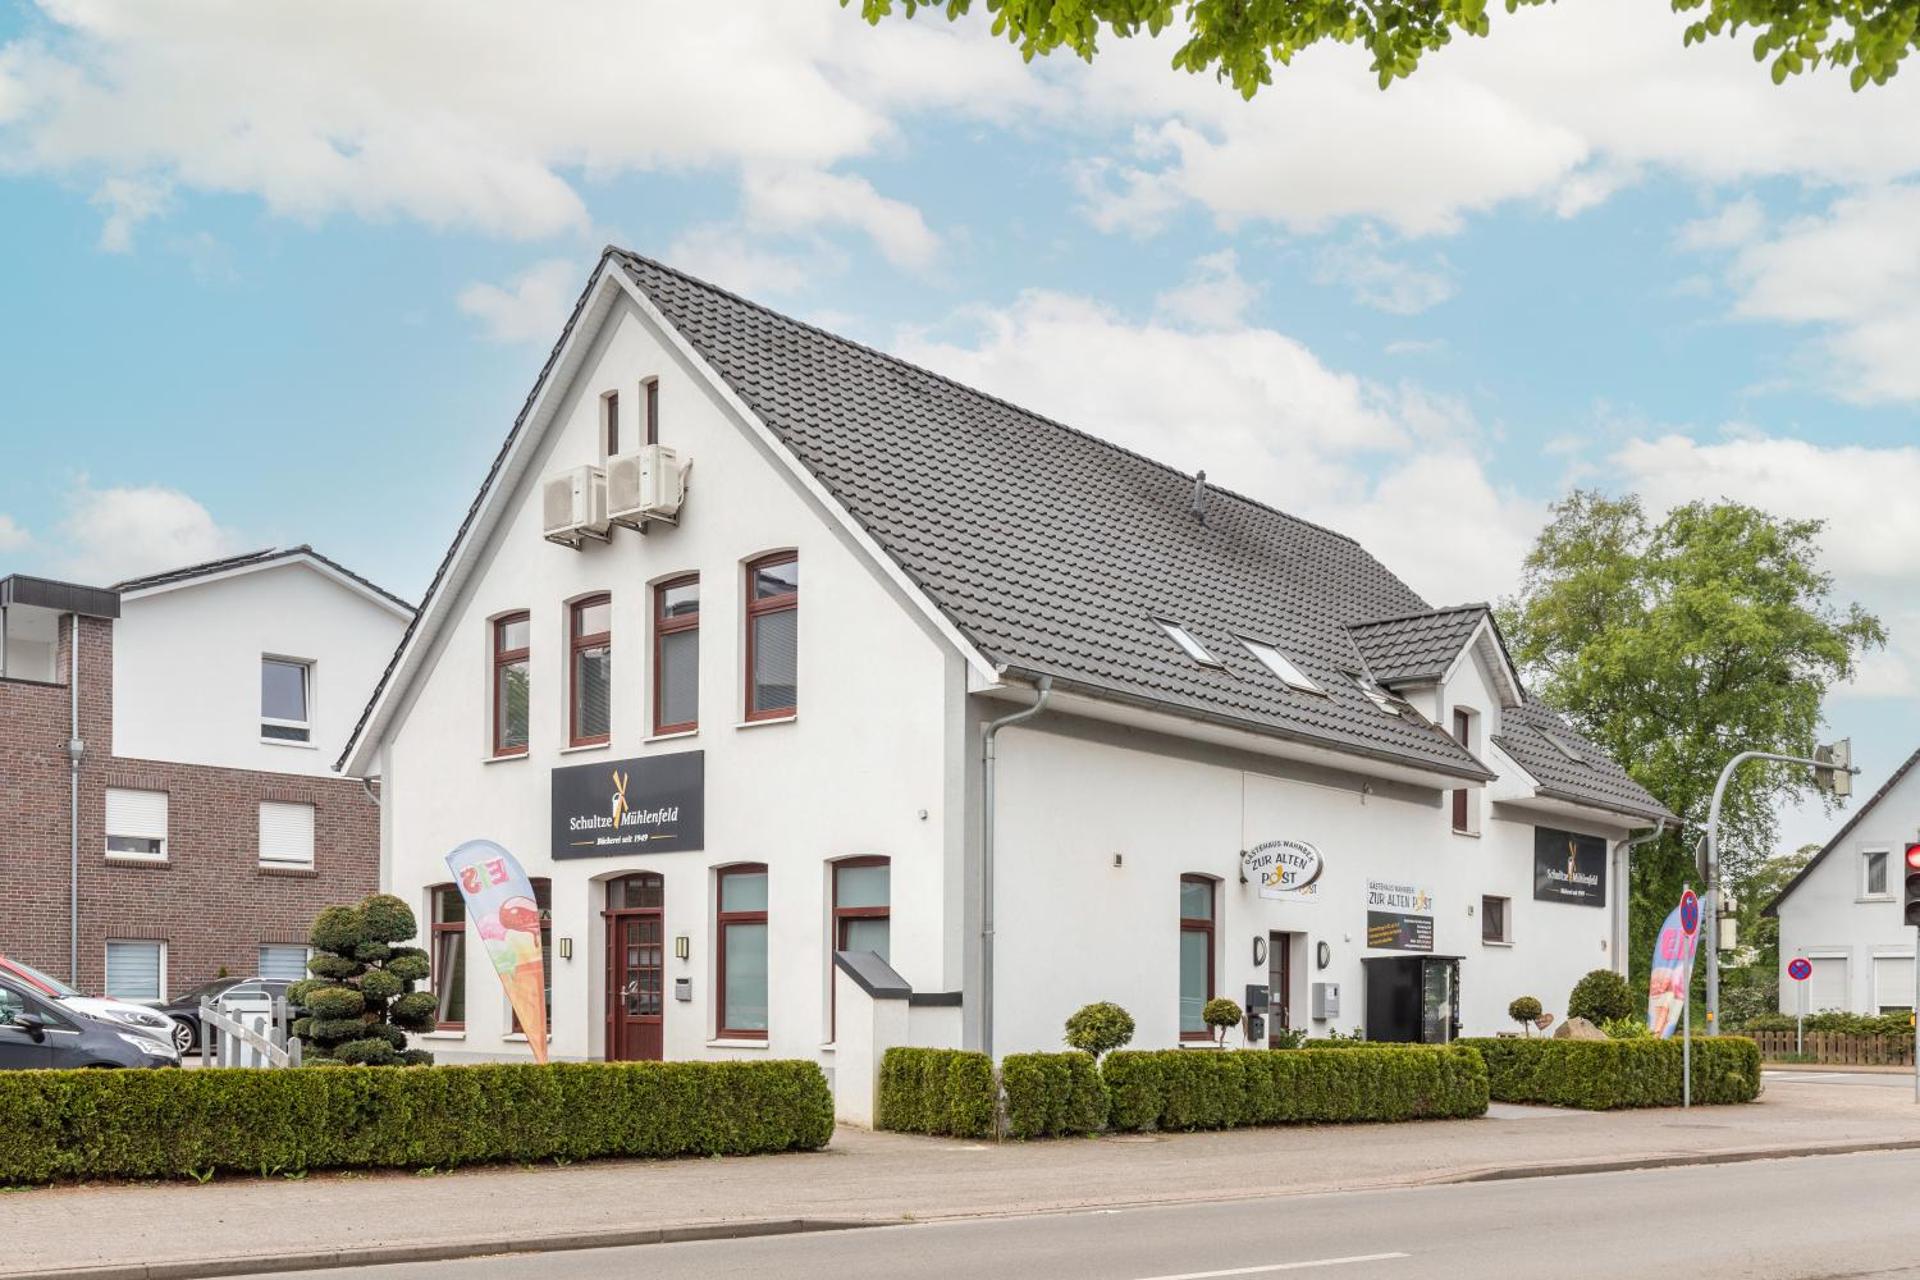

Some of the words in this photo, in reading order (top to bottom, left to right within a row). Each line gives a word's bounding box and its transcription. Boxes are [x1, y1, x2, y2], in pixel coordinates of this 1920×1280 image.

[570, 814, 613, 830] Schultze
[620, 806, 679, 826] Mühlenfeld
[596, 835, 620, 845] Bäckerei
[621, 835, 633, 844] seit
[634, 833, 649, 843] 1949
[1252, 855, 1272, 871] ZUR
[1276, 853, 1308, 870] ALTEN
[1261, 871, 1298, 885] POST
[1369, 891, 1385, 905] ZUR
[1387, 894, 1410, 908] ALTEN
